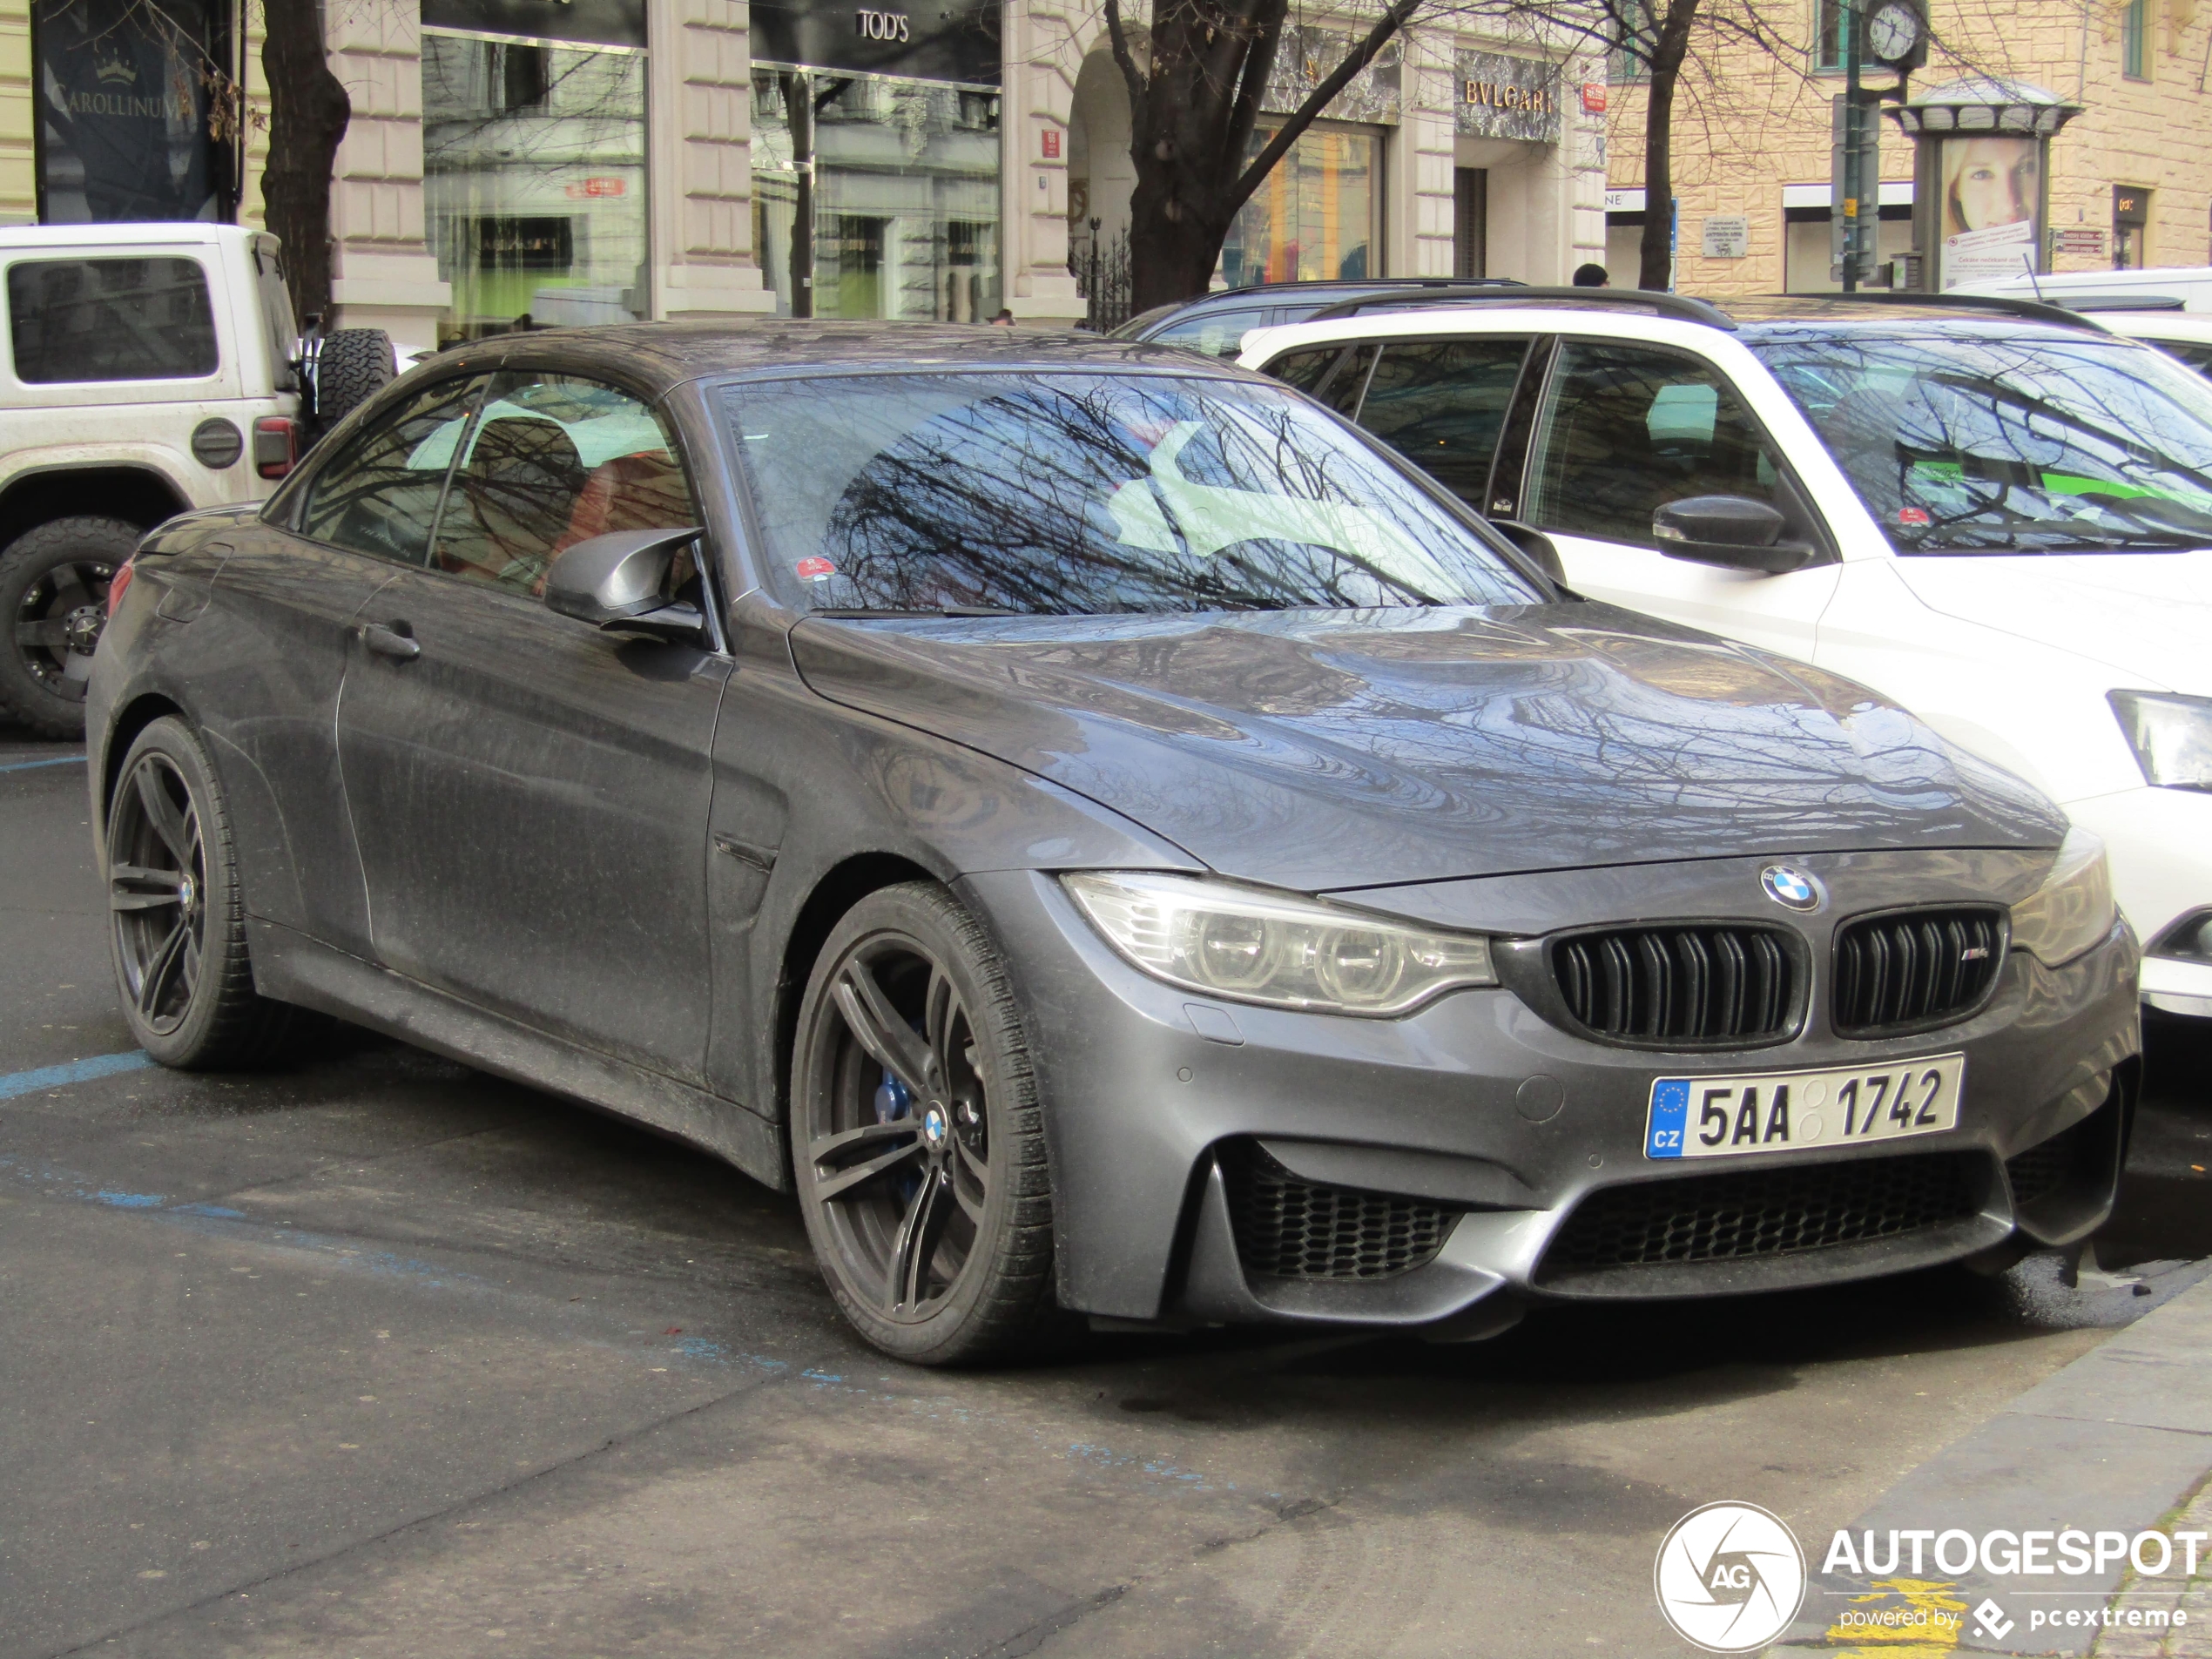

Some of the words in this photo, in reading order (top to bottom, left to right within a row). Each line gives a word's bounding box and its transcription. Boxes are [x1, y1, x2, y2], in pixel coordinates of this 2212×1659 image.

[859, 9, 908, 43] TOD'S
[51, 83, 180, 120] CAROLLINUM
[1467, 80, 1551, 113] BVLGARI
[1605, 194, 1622, 206] NE
[1698, 1084, 1789, 1146] 5AA
[1837, 1068, 1941, 1136] 1742
[1655, 1130, 1680, 1148] CZ
